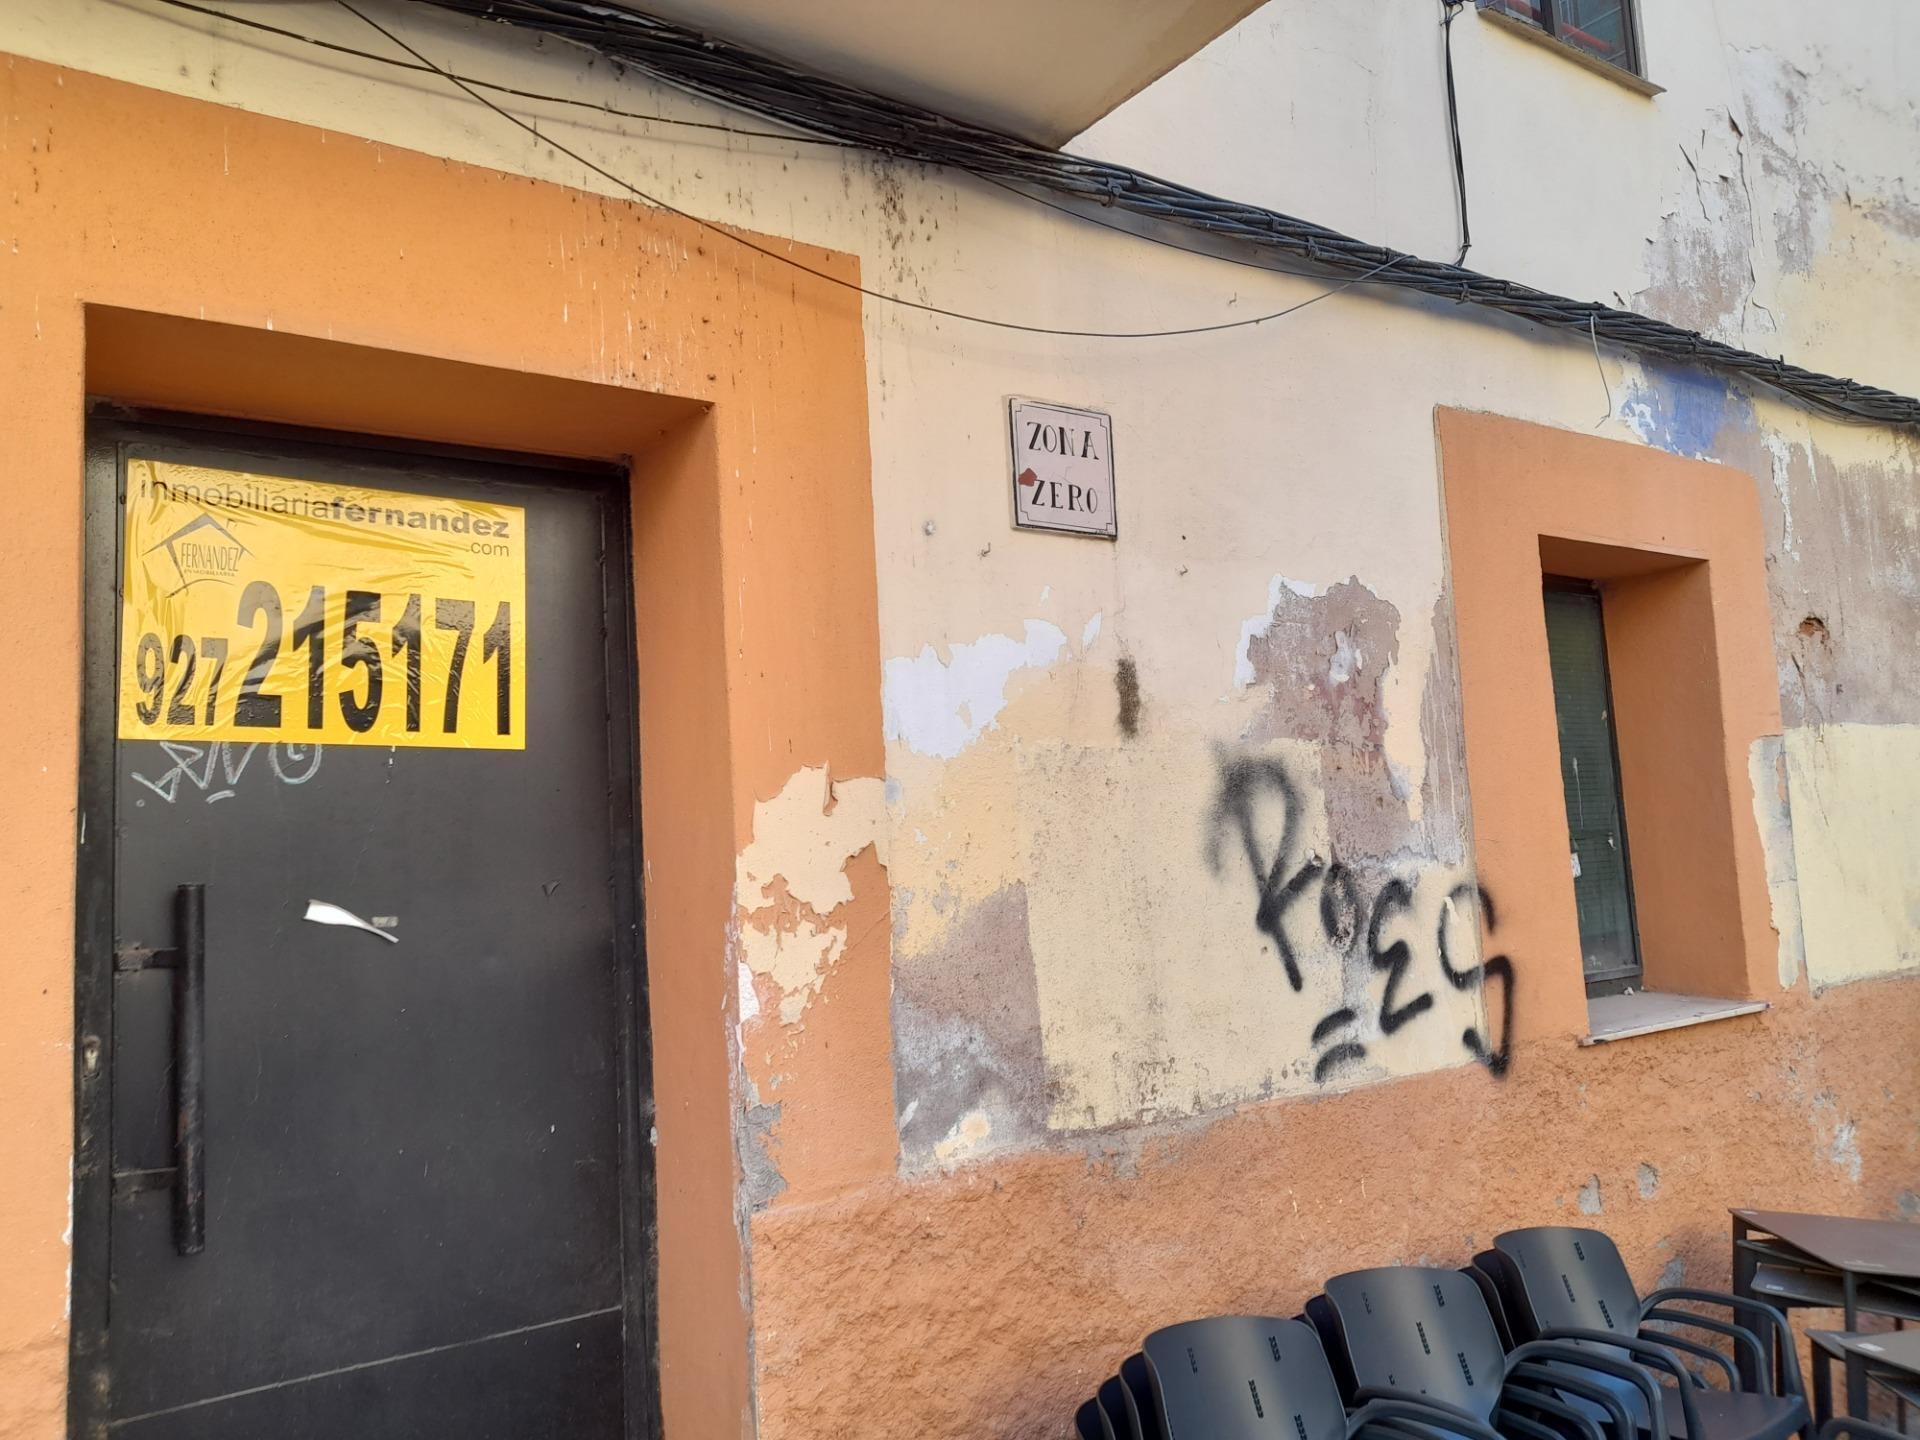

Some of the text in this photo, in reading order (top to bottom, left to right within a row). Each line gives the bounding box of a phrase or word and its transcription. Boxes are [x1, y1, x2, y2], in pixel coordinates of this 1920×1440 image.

[1026, 421, 1099, 460] ZONA
[1031, 479, 1098, 514] ZERO
[180, 542, 240, 572] FERNANDEZ
[465, 540, 510, 557] .com
